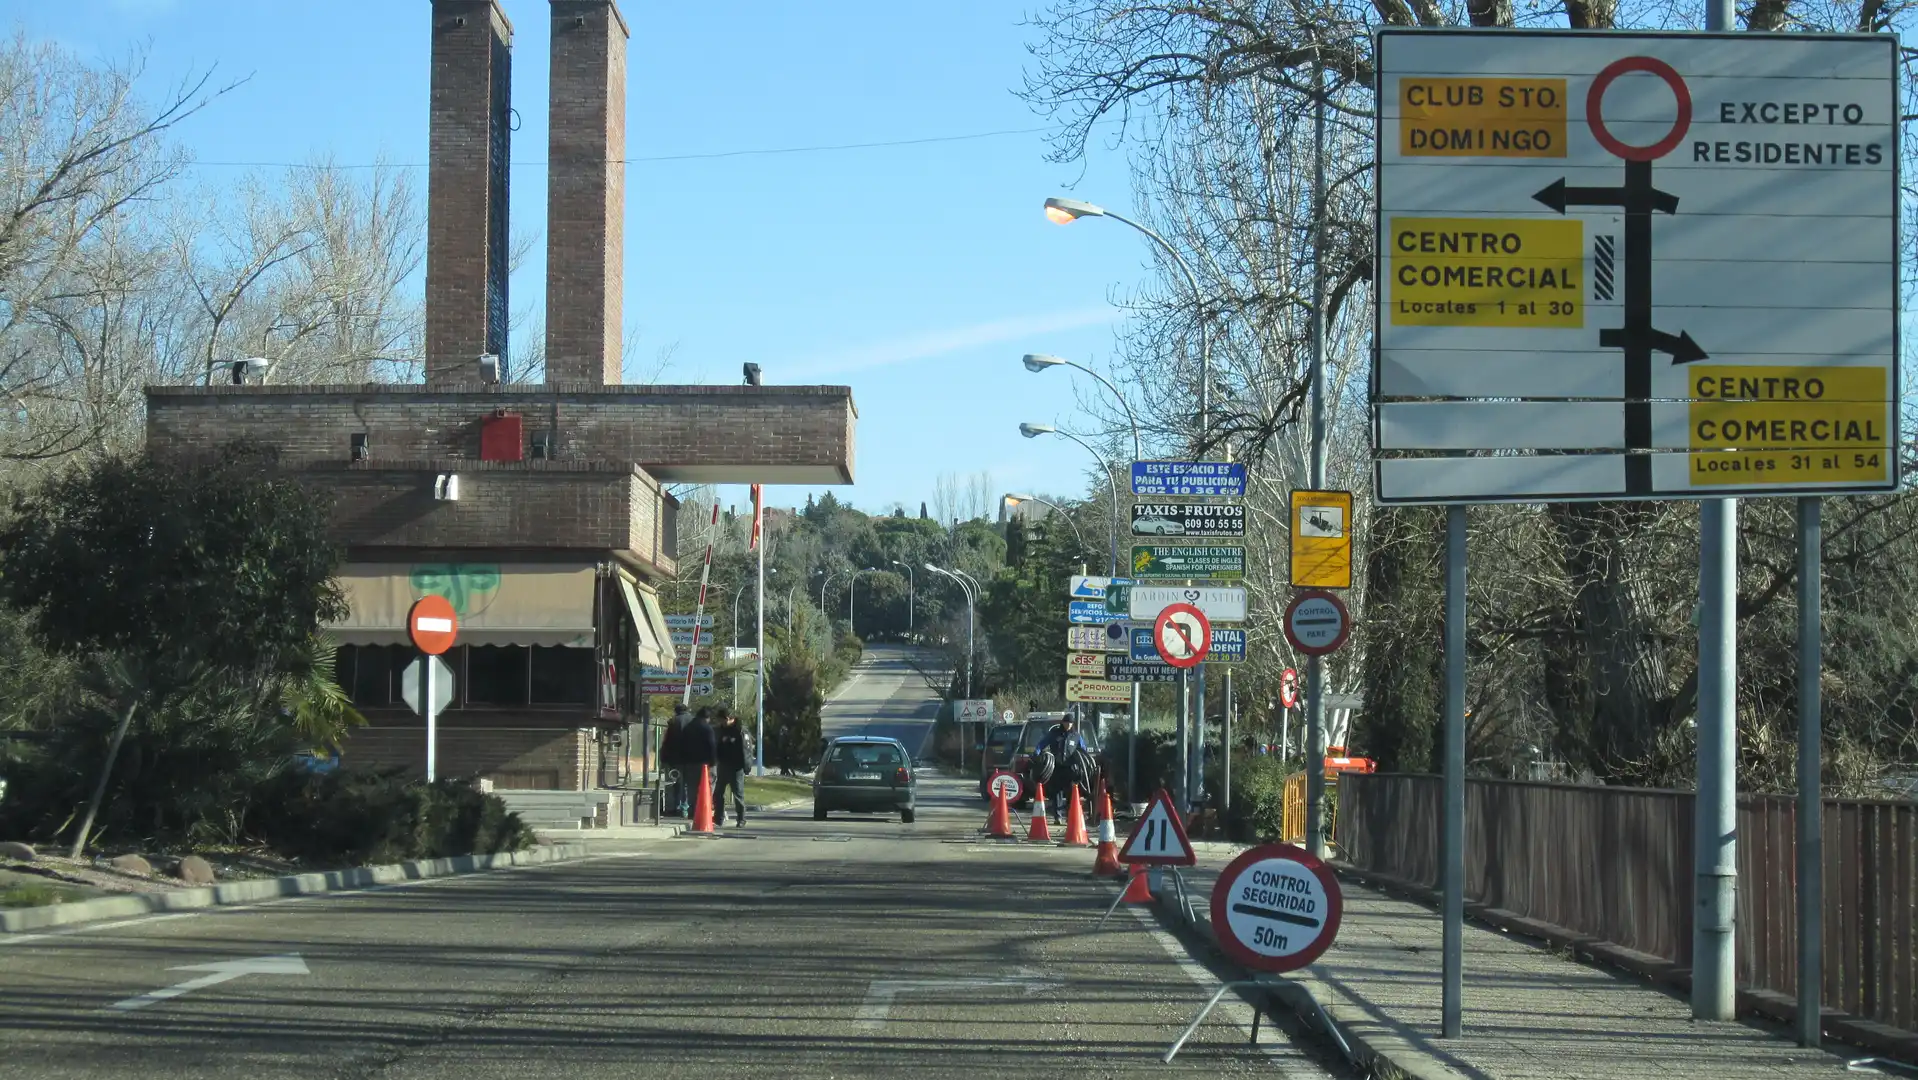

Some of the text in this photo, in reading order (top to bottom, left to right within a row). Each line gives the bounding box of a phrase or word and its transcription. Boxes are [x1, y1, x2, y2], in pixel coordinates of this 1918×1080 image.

[1406, 86, 1560, 109] CLUB STO.
[1720, 102, 1863, 125] EXCEPTO
[1410, 128, 1551, 150] DOMINGO
[1693, 141, 1882, 165] RESIDENTES
[1397, 230, 1522, 254] CENTRO
[1398, 264, 1577, 289] COMERCIAL
[1400, 299, 1575, 316] Locales 1 al 30
[1696, 376, 1824, 399] CENTRO
[1697, 419, 1881, 442] COMERCIAL
[1146, 464, 1171, 474] ESTE
[1217, 465, 1230, 475] ES
[1696, 453, 1880, 472] Locales 31 al 54
[1137, 486, 1167, 494] 902
[1171, 486, 1190, 494] 10
[1134, 505, 1243, 516] TAXIS-FRUTOS
[1184, 519, 1243, 529] 609 50 55 55
[1153, 547, 1243, 556] THE ENGLISH CENTRE
[1298, 608, 1335, 616] CONTROL
[1210, 631, 1241, 642] ENTAL
[1306, 630, 1326, 638] PARE
[1107, 656, 1124, 664] PON
[1221, 653, 1230, 661] 20
[1112, 666, 1118, 674] Y
[1119, 666, 1148, 674] MEJORA
[1150, 666, 1159, 674] TU
[1252, 870, 1312, 895] CONTROL
[1242, 886, 1316, 914] SEGURIDAD
[1253, 926, 1288, 950] 50m
